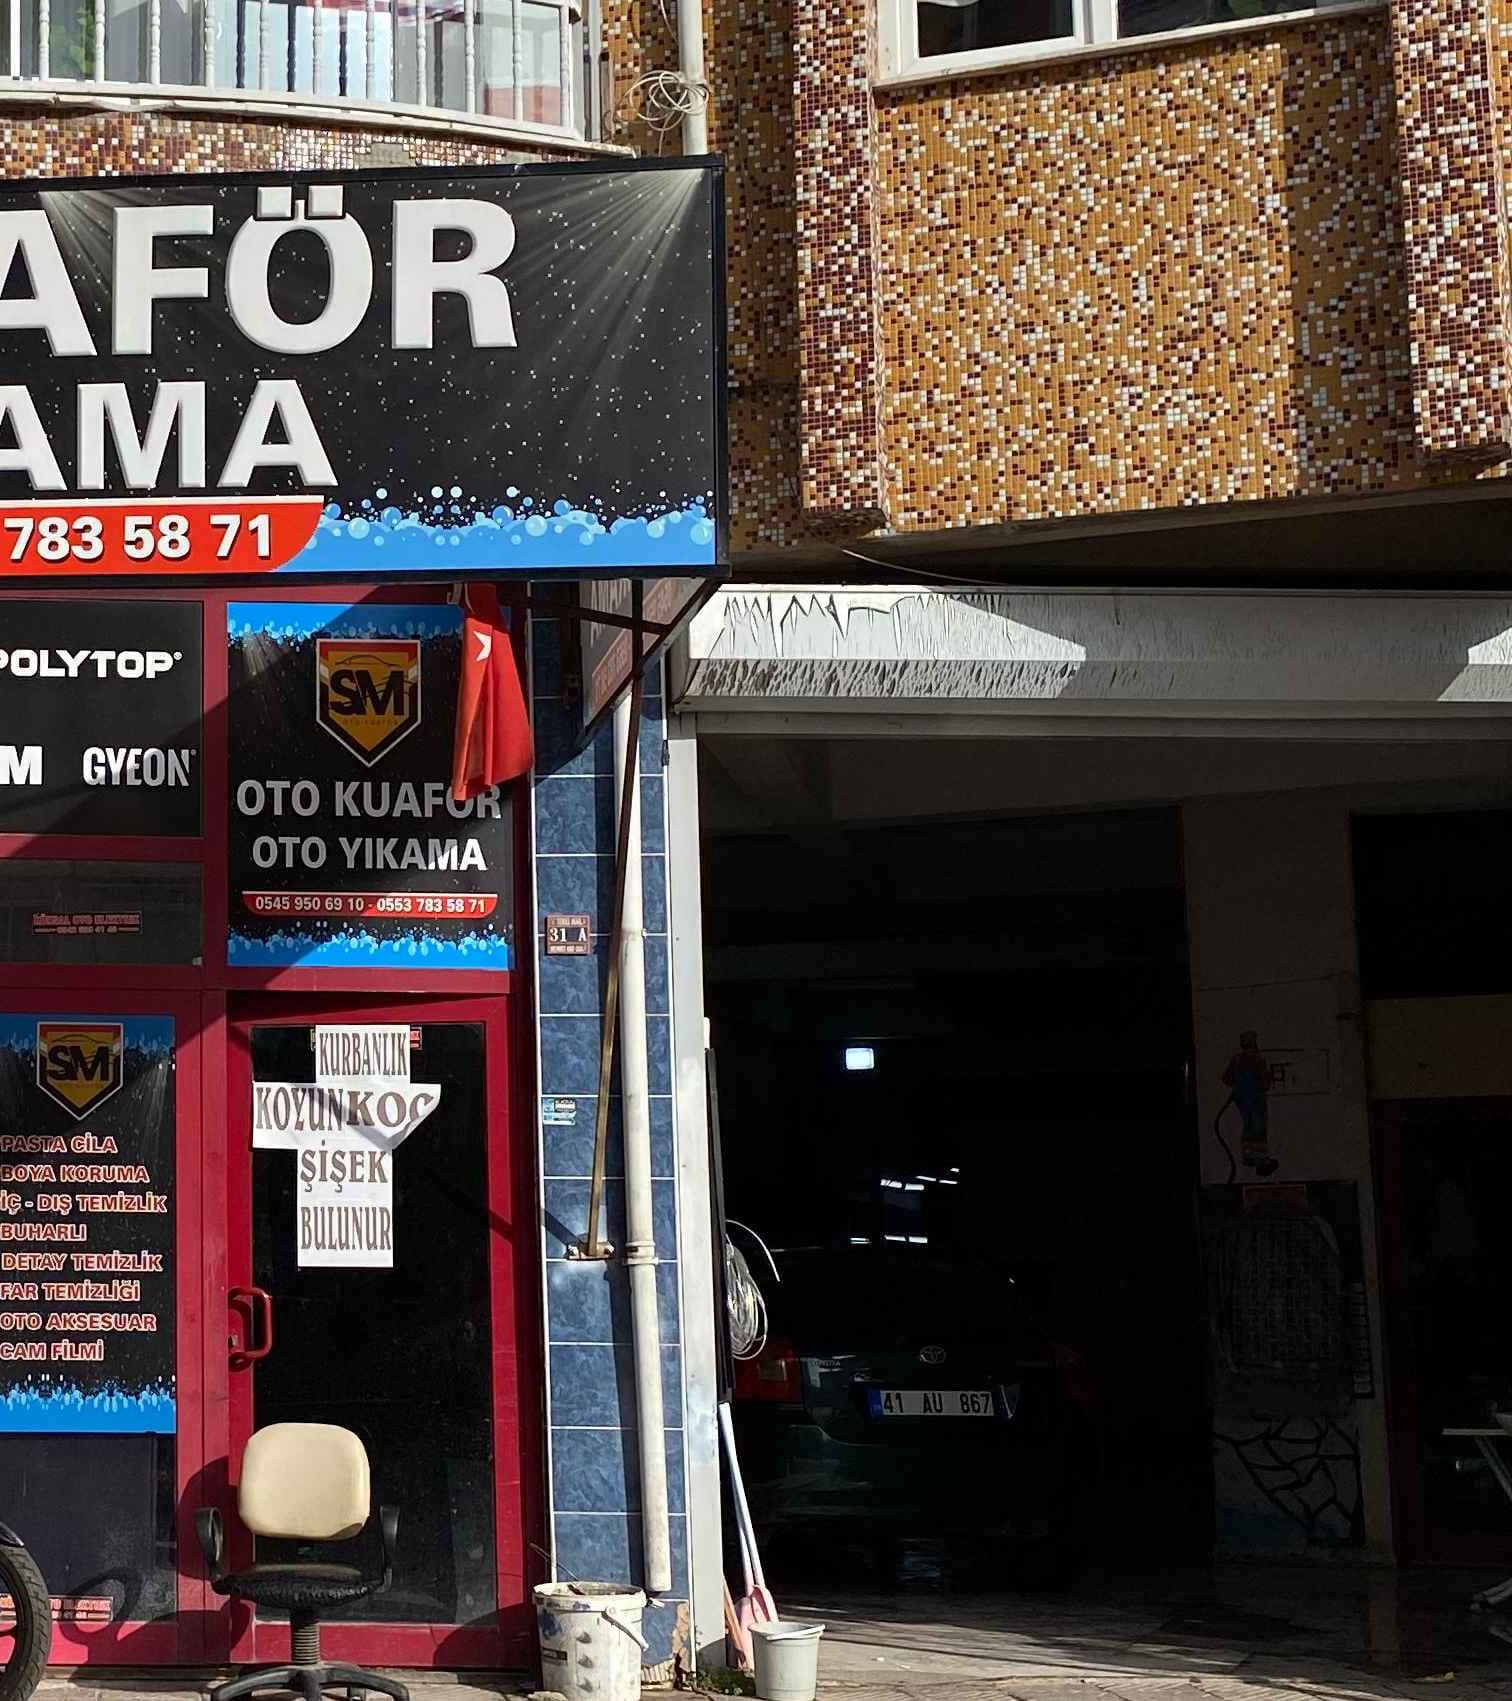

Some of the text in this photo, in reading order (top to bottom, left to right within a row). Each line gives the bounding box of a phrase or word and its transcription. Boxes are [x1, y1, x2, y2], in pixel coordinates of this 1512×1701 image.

[3, 514, 104, 562] 783
[123, 513, 191, 560] 58
[209, 513, 273, 558] 71
[329, 669, 405, 716] SM
[237, 779, 320, 817] OTO
[252, 836, 489, 871] OTO YIKAMA
[255, 896, 290, 910] 0545
[294, 896, 321, 911] 950
[325, 897, 343, 911] 69
[347, 897, 364, 911] 10
[376, 897, 412, 912] 0553
[416, 897, 443, 913] 783
[446, 898, 465, 913] 58
[469, 898, 486, 913] 71
[549, 927, 588, 943] 31 A
[47, 1045, 110, 1081] SM
[319, 1032, 408, 1076] KURBANLIK
[256, 1086, 344, 1131] KOYUN
[71, 1132, 118, 1153] CİLA
[1, 1165, 150, 1183] BOYA KORUMA
[300, 1139, 388, 1193] ŞİŞEK
[37, 1194, 72, 1215] DIŞ
[76, 1191, 168, 1213] TEMİZLİK
[0, 1223, 88, 1241] BUHARLI
[300, 1206, 391, 1251] BULUNUR
[1, 1250, 163, 1272] DETAY TEMİZLİK
[0, 1280, 141, 1302] FAR TEMİZLİĞİ
[0, 1313, 157, 1332] OTO AKSESUAR
[0, 1339, 104, 1361] CAM FİLMİ
[883, 1391, 990, 1414] 41 AU 867
